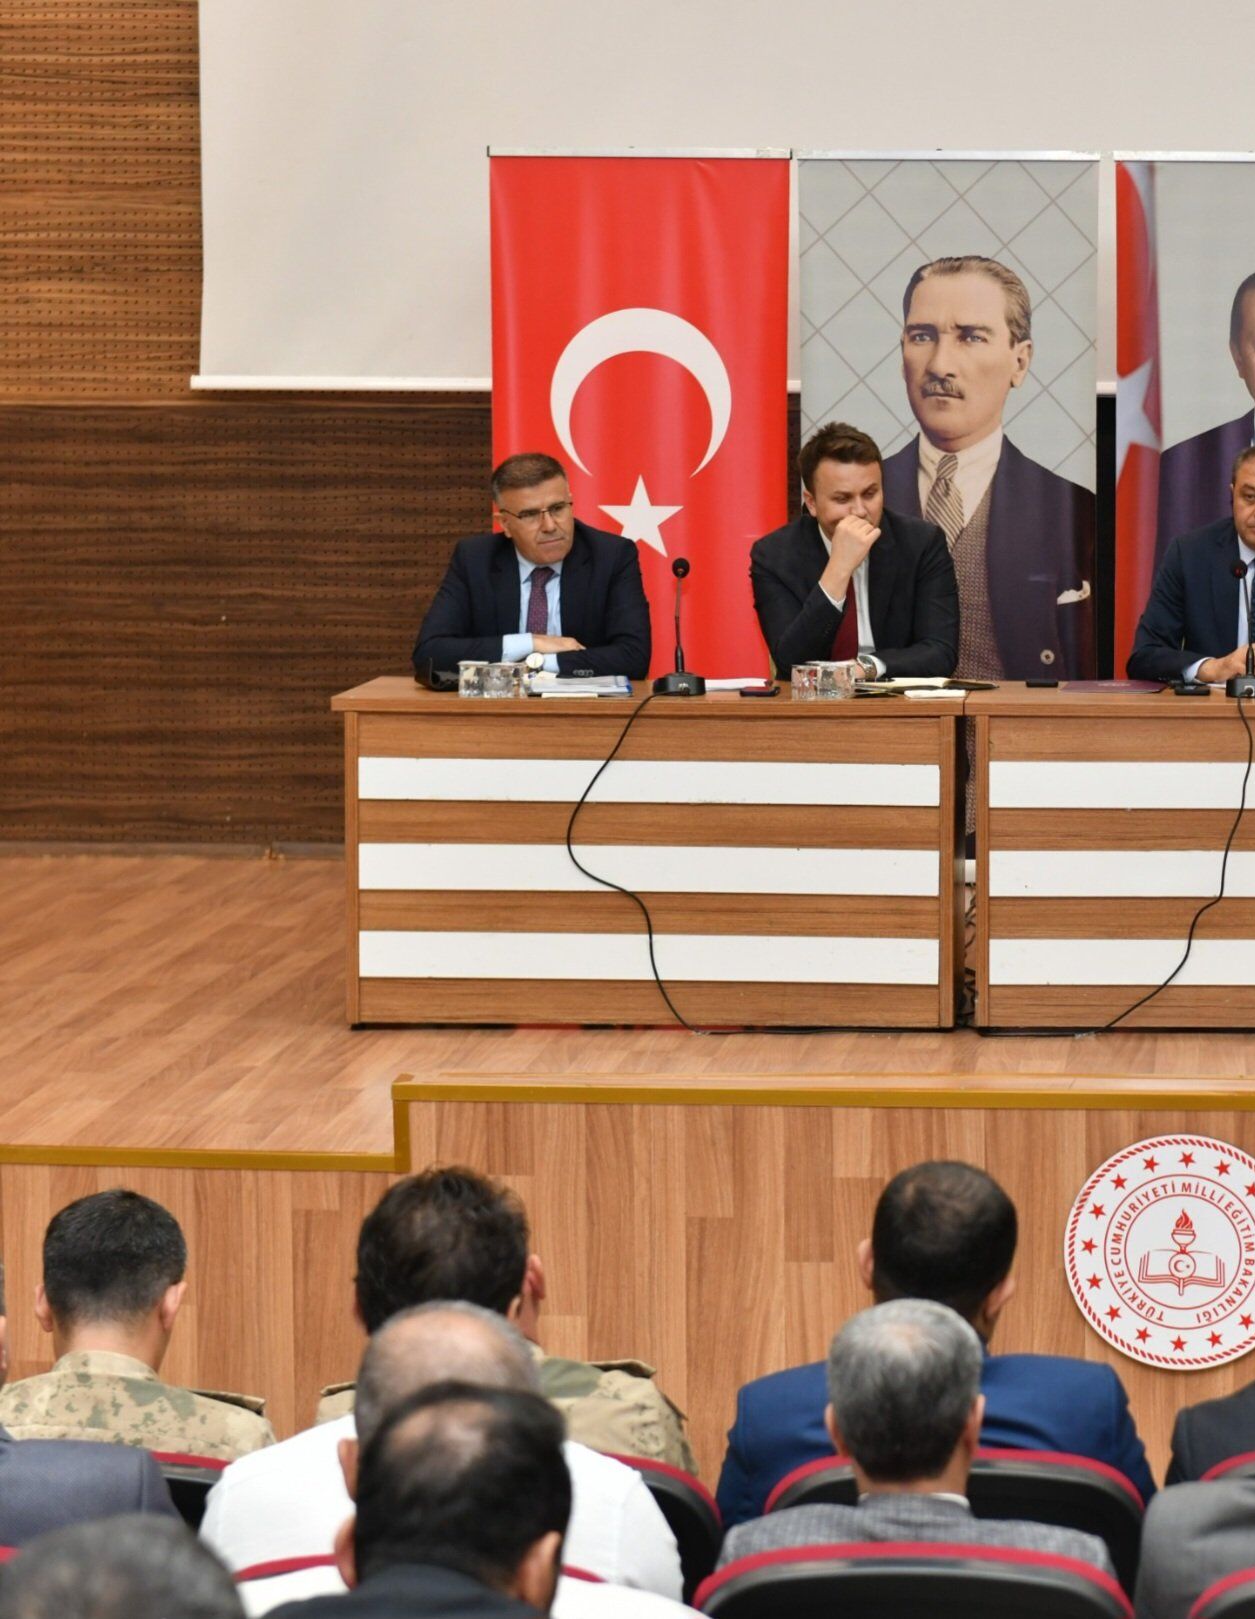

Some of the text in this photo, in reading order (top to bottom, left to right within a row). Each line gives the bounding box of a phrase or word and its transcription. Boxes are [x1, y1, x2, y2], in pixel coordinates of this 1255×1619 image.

[1110, 1181, 1255, 1323] TÜRKİYE CUMHURİYETİ MİLLİ EĞİTİM BAKANLIĞI
